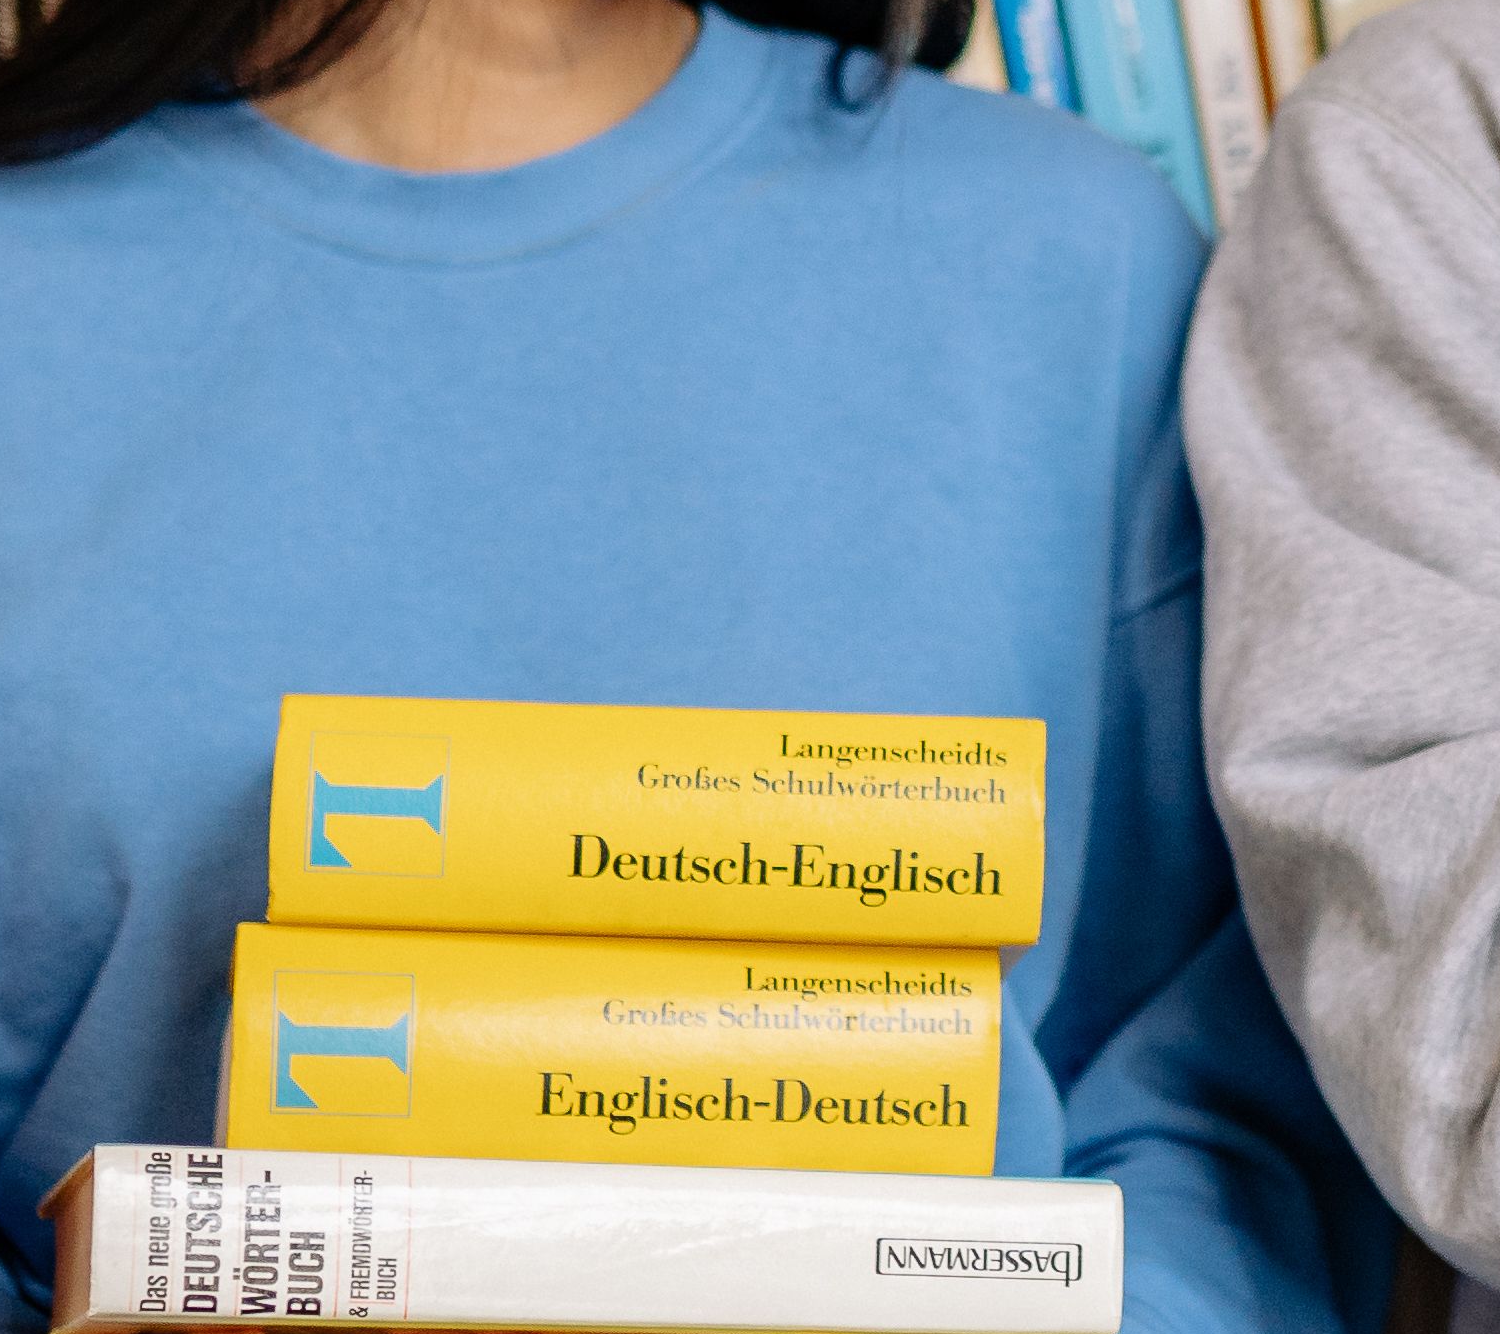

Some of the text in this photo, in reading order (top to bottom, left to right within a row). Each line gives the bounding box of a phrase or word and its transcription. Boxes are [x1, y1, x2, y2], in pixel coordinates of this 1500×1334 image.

[637, 763, 1007, 805] Großes Schulwörterbuch
[779, 733, 1008, 768] Langenscheidts
[567, 833, 1004, 907] Deutsch-Englisch
[602, 998, 973, 1035] Großes Schulwörterbuch
[743, 966, 973, 1001] Langenscheidts
[535, 1071, 969, 1136] Englisch-Deutsch
[140, 1152, 177, 1312] Das neue große
[182, 1153, 223, 1313] DEUTSCHE
[233, 1170, 281, 1315] WÖRTER-
[348, 1170, 374, 1318] & FREMDWÖRTER-
[286, 1231, 325, 1316] BUCH
[377, 1257, 397, 1301] BUCH
